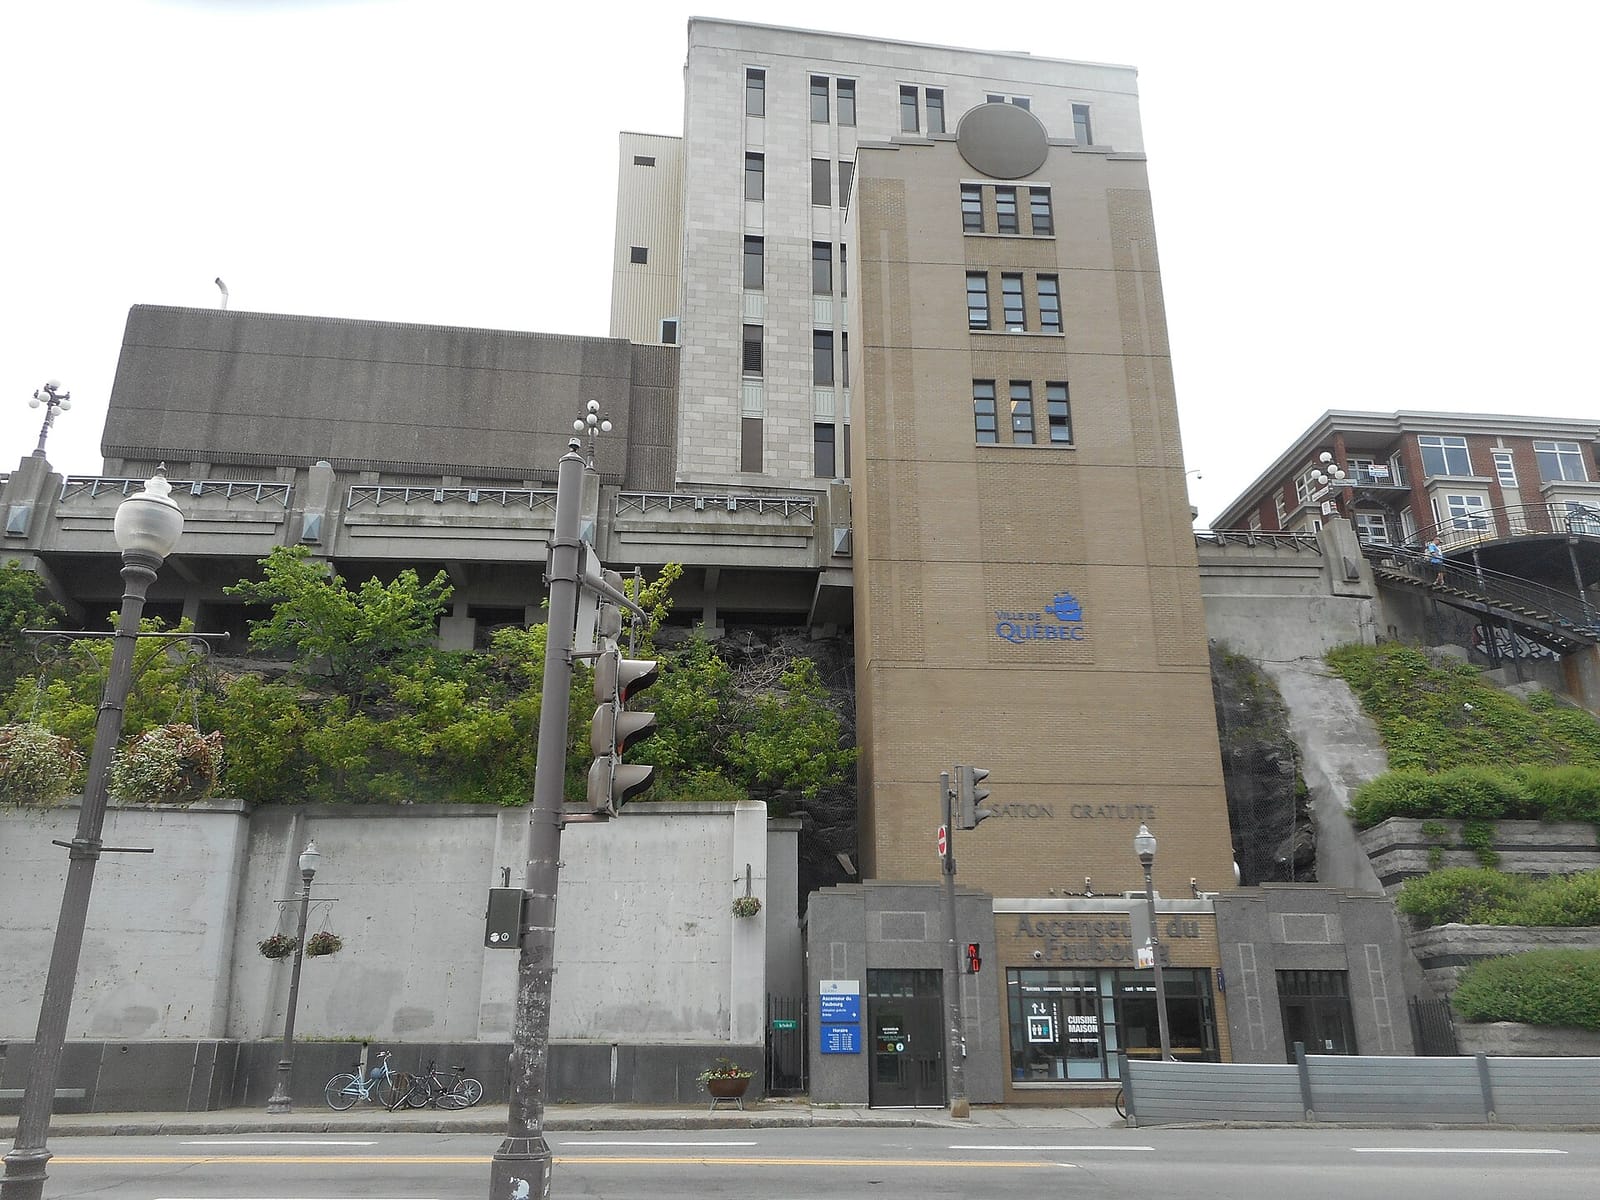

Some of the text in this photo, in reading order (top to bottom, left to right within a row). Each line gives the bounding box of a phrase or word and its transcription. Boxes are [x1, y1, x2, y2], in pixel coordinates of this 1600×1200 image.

[995, 611, 1041, 621] VILLE DE
[995, 621, 1084, 644] QUÉBEC
[990, 804, 1157, 819] SATION GRATUITE
[1016, 912, 1200, 938] Ascenseu du
[1068, 1015, 1098, 1024] CUISINE
[1068, 1024, 1099, 1033] MAISON
